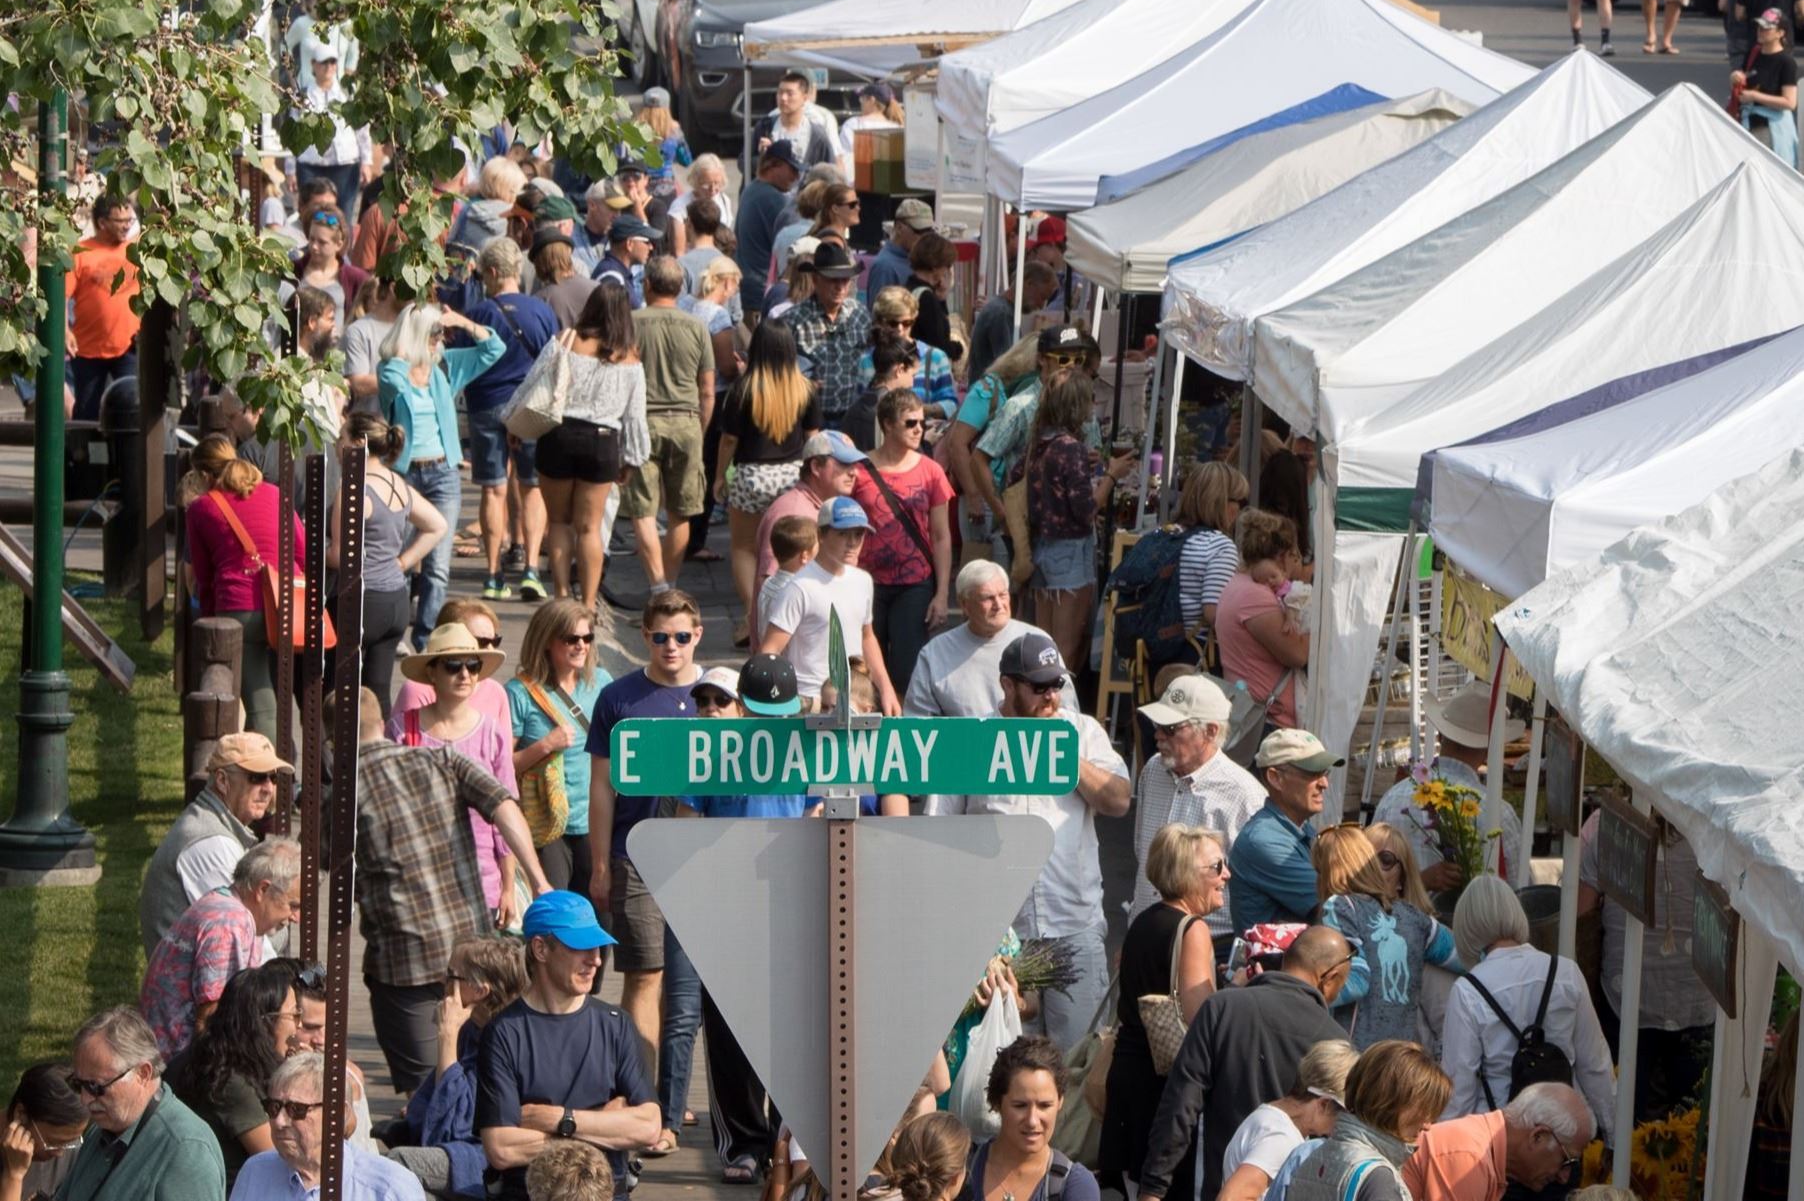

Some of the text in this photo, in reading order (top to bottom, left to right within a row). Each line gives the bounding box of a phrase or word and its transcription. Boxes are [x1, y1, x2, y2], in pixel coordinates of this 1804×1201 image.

[619, 730, 1070, 784] E BROADWAY AVE
